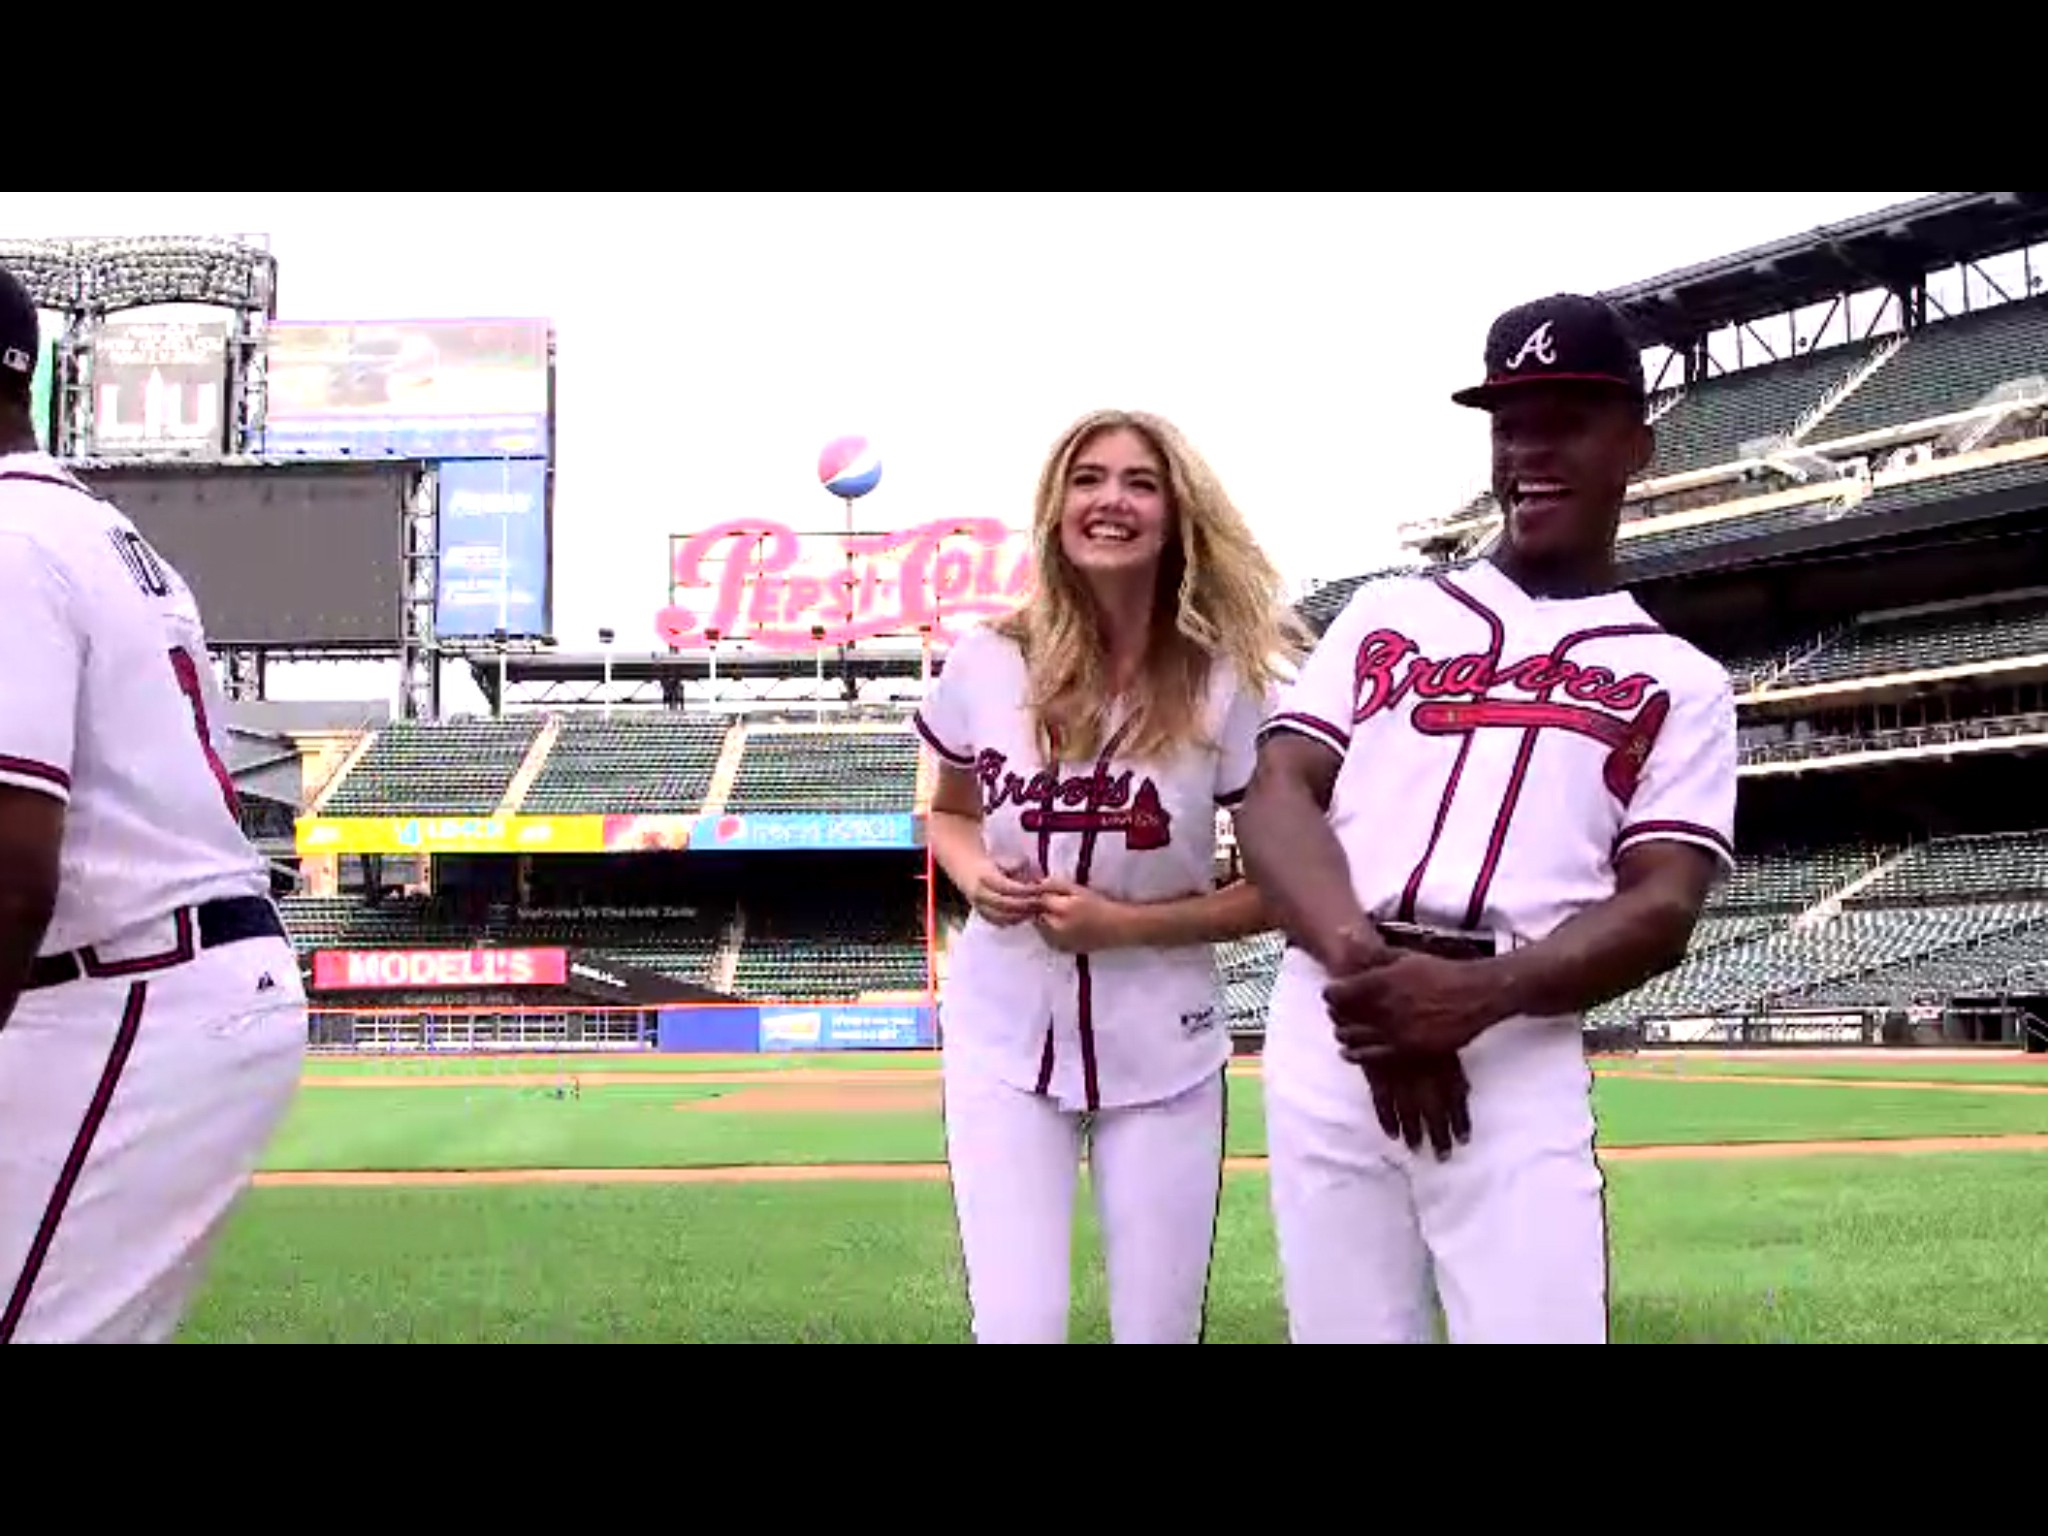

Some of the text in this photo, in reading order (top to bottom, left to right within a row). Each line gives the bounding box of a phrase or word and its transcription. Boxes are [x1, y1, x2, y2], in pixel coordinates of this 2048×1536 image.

[1506, 319, 1557, 369] A
[1352, 628, 1659, 725] Braves
[974, 747, 1134, 816] Braves
[348, 952, 534, 984] MODELL'S
